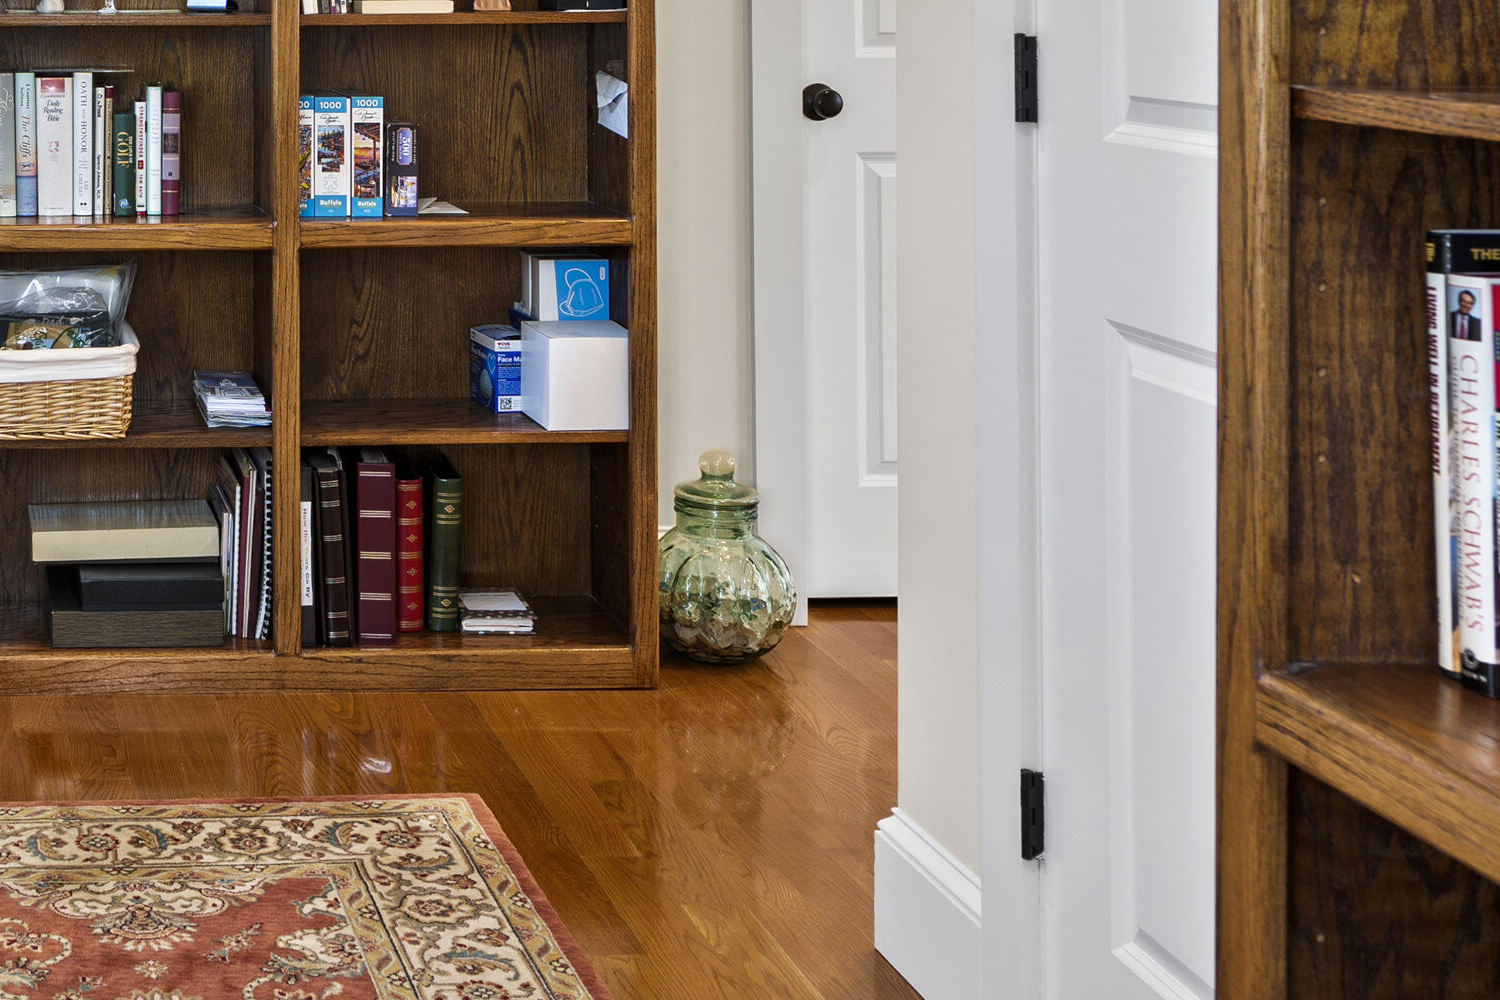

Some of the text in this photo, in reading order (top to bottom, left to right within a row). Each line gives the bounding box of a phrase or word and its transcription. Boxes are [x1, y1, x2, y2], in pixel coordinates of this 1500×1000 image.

[80, 81, 88, 106] OATH
[357, 99, 378, 107] 1000
[43, 106, 63, 114] Reading
[319, 101, 342, 109] 1000
[46, 113, 60, 121] Bible
[19, 115, 32, 158] The Cliffs
[80, 121, 88, 153] HONOR
[116, 131, 130, 168] GOLF
[402, 137, 411, 156] 500
[1470, 248, 1500, 261] THE
[1459, 354, 1484, 631] CHARLES SCHWAB'S
